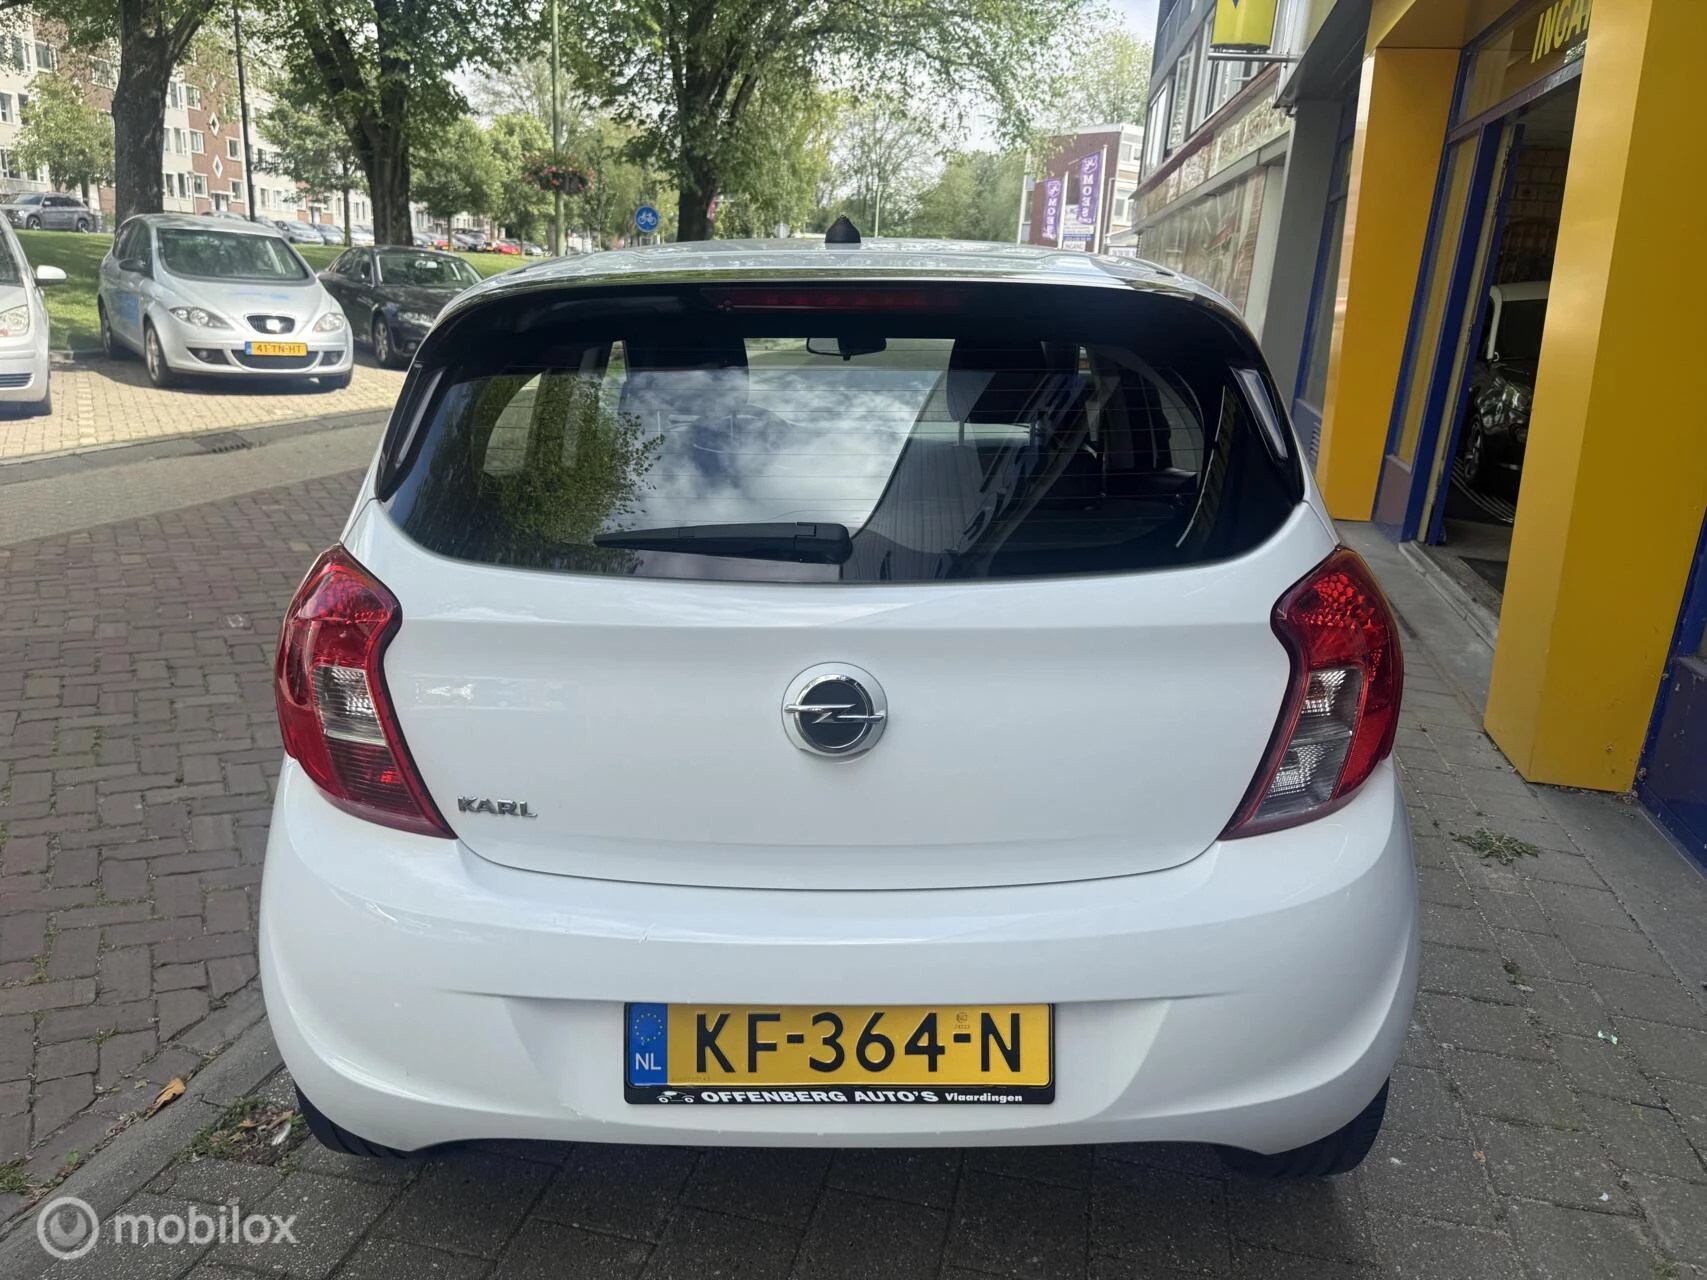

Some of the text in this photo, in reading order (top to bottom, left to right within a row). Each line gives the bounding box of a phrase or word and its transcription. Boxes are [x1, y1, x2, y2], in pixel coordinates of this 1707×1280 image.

[457, 796, 538, 818] KARL
[696, 1011, 1020, 1073] KF-364-N
[635, 1053, 662, 1071] NL
[701, 1090, 1023, 1104] OFFENBERG AUTO'S Vlaardingen
